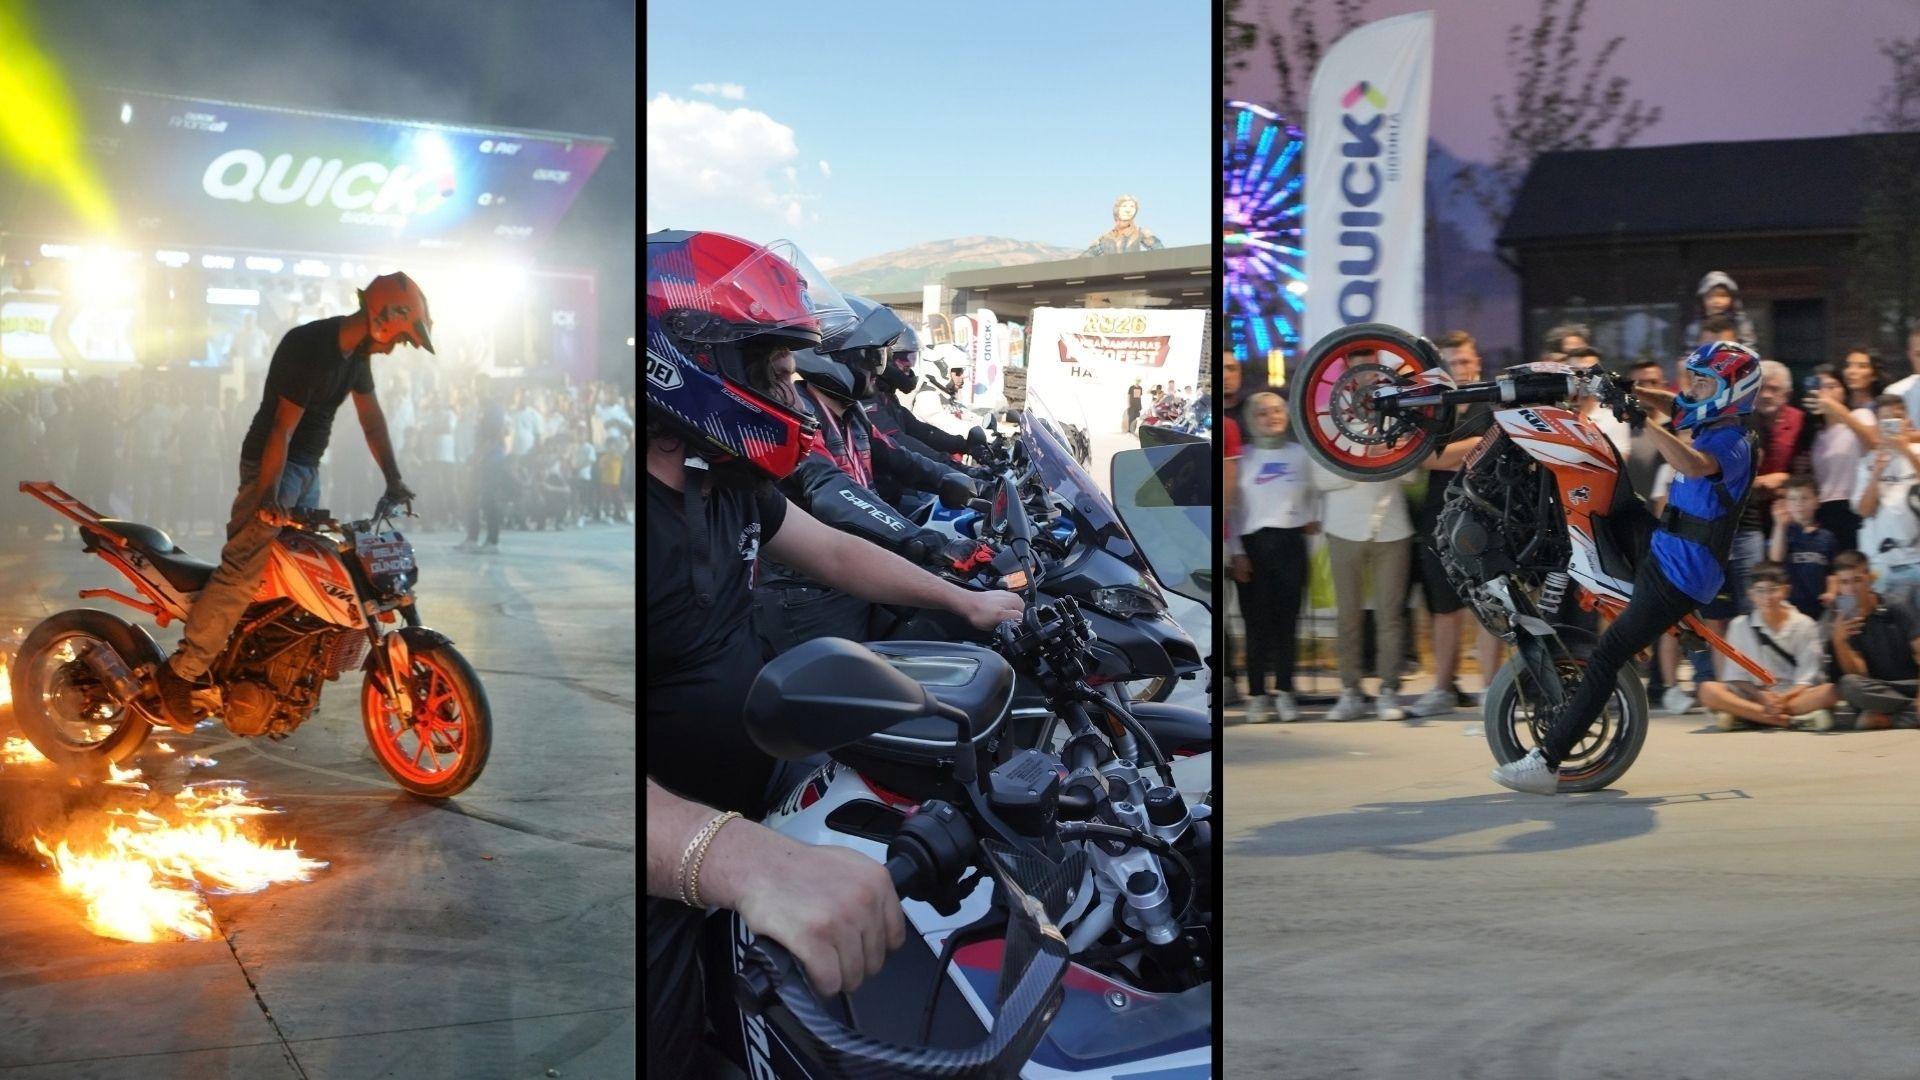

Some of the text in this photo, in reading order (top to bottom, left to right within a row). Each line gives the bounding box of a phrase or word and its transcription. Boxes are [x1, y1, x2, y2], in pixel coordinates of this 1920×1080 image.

[202, 149, 420, 213] QUICK
[1338, 113, 1386, 326] QUICK
[838, 489, 906, 532] DAINESE
